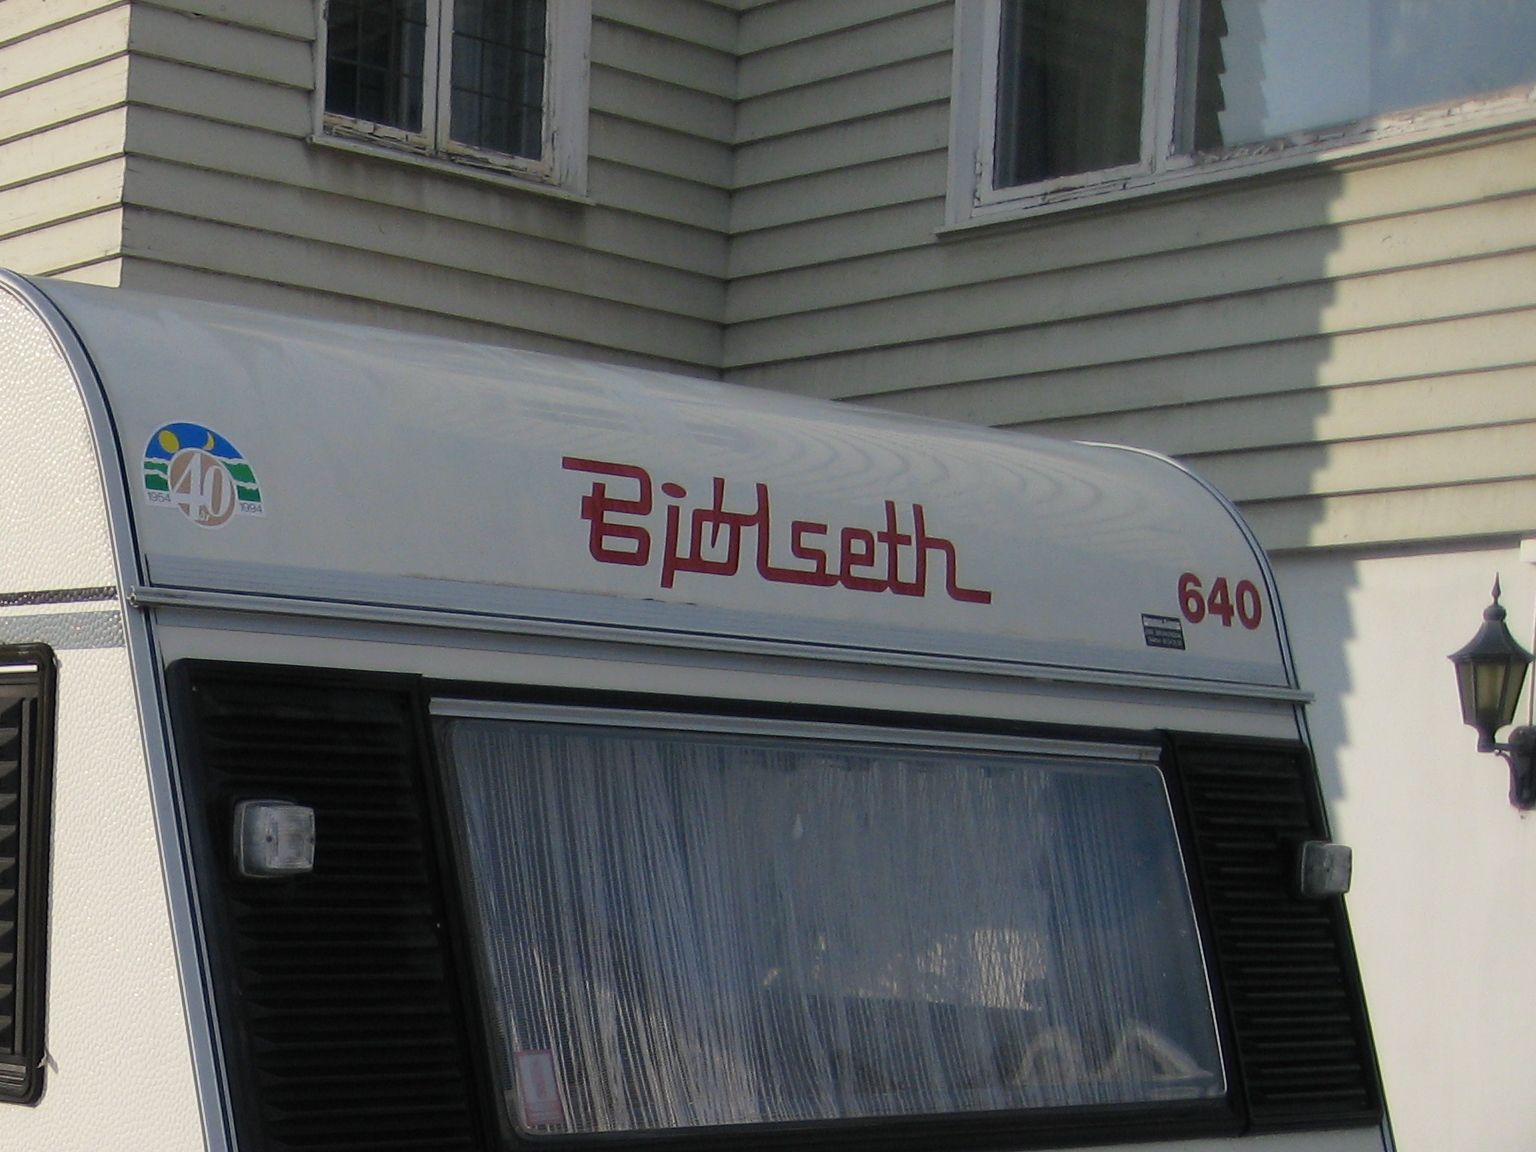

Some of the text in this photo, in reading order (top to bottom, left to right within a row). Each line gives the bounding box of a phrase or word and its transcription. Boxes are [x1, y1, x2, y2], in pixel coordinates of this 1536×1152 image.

[147, 492, 172, 502] 1954
[172, 452, 233, 520] 40
[1178, 572, 1262, 630] 640
